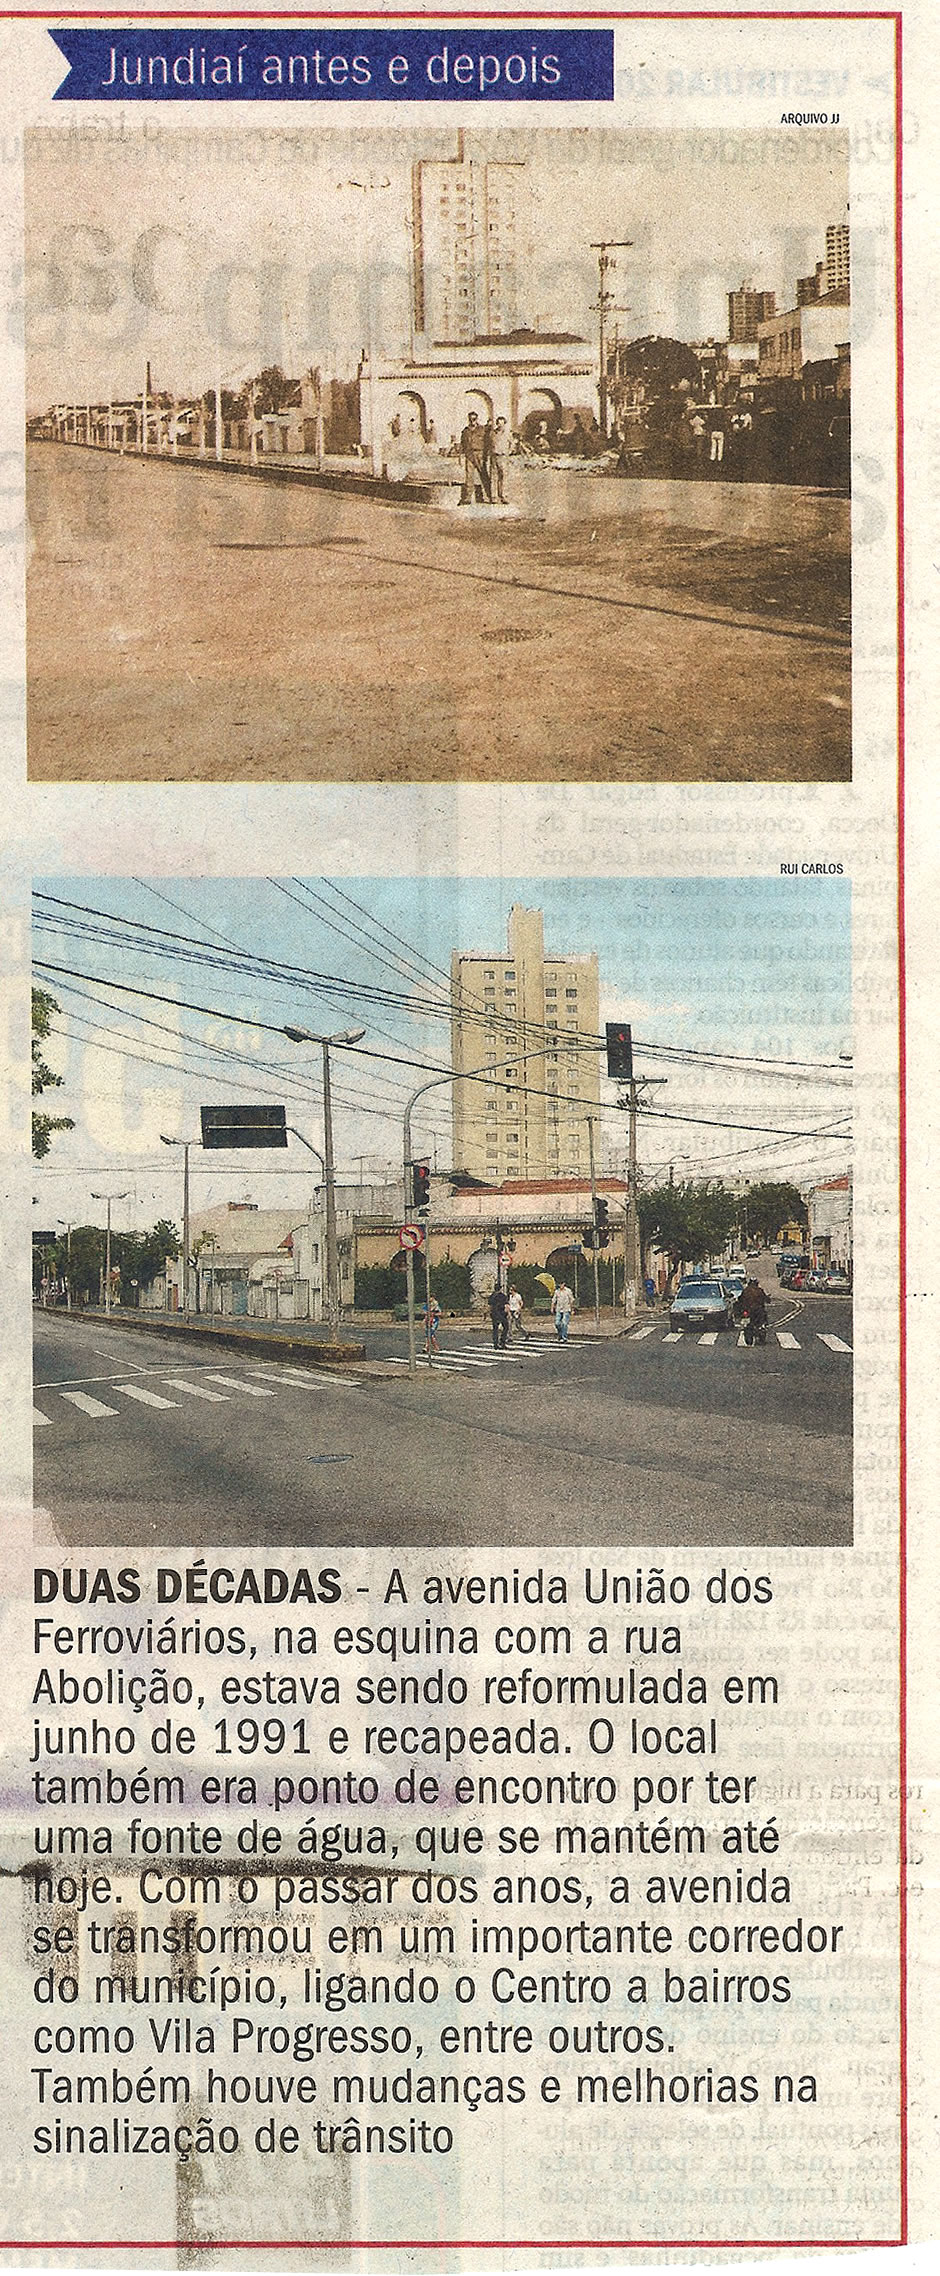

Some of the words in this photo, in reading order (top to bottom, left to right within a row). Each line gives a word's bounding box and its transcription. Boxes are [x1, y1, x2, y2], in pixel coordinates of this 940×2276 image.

[102, 45, 248, 85] Jundiaí
[262, 50, 371, 84] antes
[388, 55, 409, 84] e
[426, 47, 561, 91] depois
[781, 113, 828, 126] ARQUIVO
[830, 113, 840, 124] JJ
[780, 863, 798, 875] RUI
[801, 863, 844, 875] CARLOS
[35, 1568, 140, 1603] DUAS
[158, 1562, 341, 1603] DÉCADAS
[384, 1569, 407, 1603] A
[424, 1569, 566, 1604] avenida
[586, 1568, 689, 1603] União
[707, 1569, 772, 1603] dos
[35, 1617, 256, 1659] Ferroviários,
[275, 1627, 316, 1654] na
[334, 1619, 477, 1660] esquina
[496, 1627, 570, 1653] com
[589, 1627, 607, 1653] a
[626, 1627, 680, 1654] rua
[33, 1669, 204, 1710] Abolição,
[222, 1672, 339, 1704] estava
[357, 1669, 467, 1704] sendo
[486, 1668, 706, 1704] reformulada
[725, 1677, 777, 1703] em
[30, 1719, 134, 1760] junho
[152, 1719, 195, 1754] de
[216, 1719, 310, 1754] 1991
[330, 1728, 348, 1753] e
[366, 1719, 570, 1760] recapeada.
[590, 1718, 613, 1753] O
[632, 1719, 715, 1754] local
[32, 1767, 183, 1804] também
[202, 1777, 256, 1804] era
[274, 1772, 378, 1810] ponto
[395, 1769, 439, 1803] de
[455, 1772, 615, 1804] encontro
[635, 1777, 693, 1810] por
[706, 1772, 756, 1803] ter
[35, 1827, 111, 1853] uma
[128, 1819, 221, 1853] fonte
[238, 1819, 281, 1853] de
[298, 1817, 398, 1860] água,
[416, 1827, 483, 1860] que
[499, 1827, 539, 1853] se
[557, 1817, 704, 1853] mantém
[723, 1817, 779, 1853] até
[33, 1869, 123, 1911] hoje.
[140, 1869, 221, 1904] Com
[237, 1877, 258, 1904] o
[275, 1877, 398, 1911] passar
[412, 1869, 478, 1904] dos
[494, 1877, 592, 1909] anos,
[610, 1877, 628, 1904] a
[647, 1869, 790, 1904] avenida
[33, 1926, 75, 1954] se
[88, 1919, 311, 1954] transformou
[329, 1927, 382, 1954] em
[401, 1927, 453, 1953] um
[473, 1919, 672, 1960] importante
[689, 1919, 843, 1952] corredor
[34, 1967, 78, 2003] do
[96, 1966, 287, 2010] município,
[305, 1968, 438, 2010] ligando
[456, 1977, 475, 2003] o
[492, 1968, 610, 2003] Centro
[628, 1976, 646, 2002] a
[665, 1968, 790, 2002] bairros
[35, 2027, 133, 2053] como
[149, 2019, 214, 2053] Vila
[234, 2018, 422, 2060] Progresso,
[441, 2021, 532, 2053] entre
[550, 2021, 673, 2053] outros.
[33, 2067, 190, 2104] Também
[209, 2069, 316, 2103] houve
[334, 2069, 525, 2110] mudanças
[541, 2077, 560, 2103] e
[578, 2068, 758, 2102] melhorias
[776, 2076, 816, 2102] na
[34, 2117, 238, 2160] sinalização
[255, 2119, 299, 2153] de
[314, 2117, 452, 2153] trânsito
